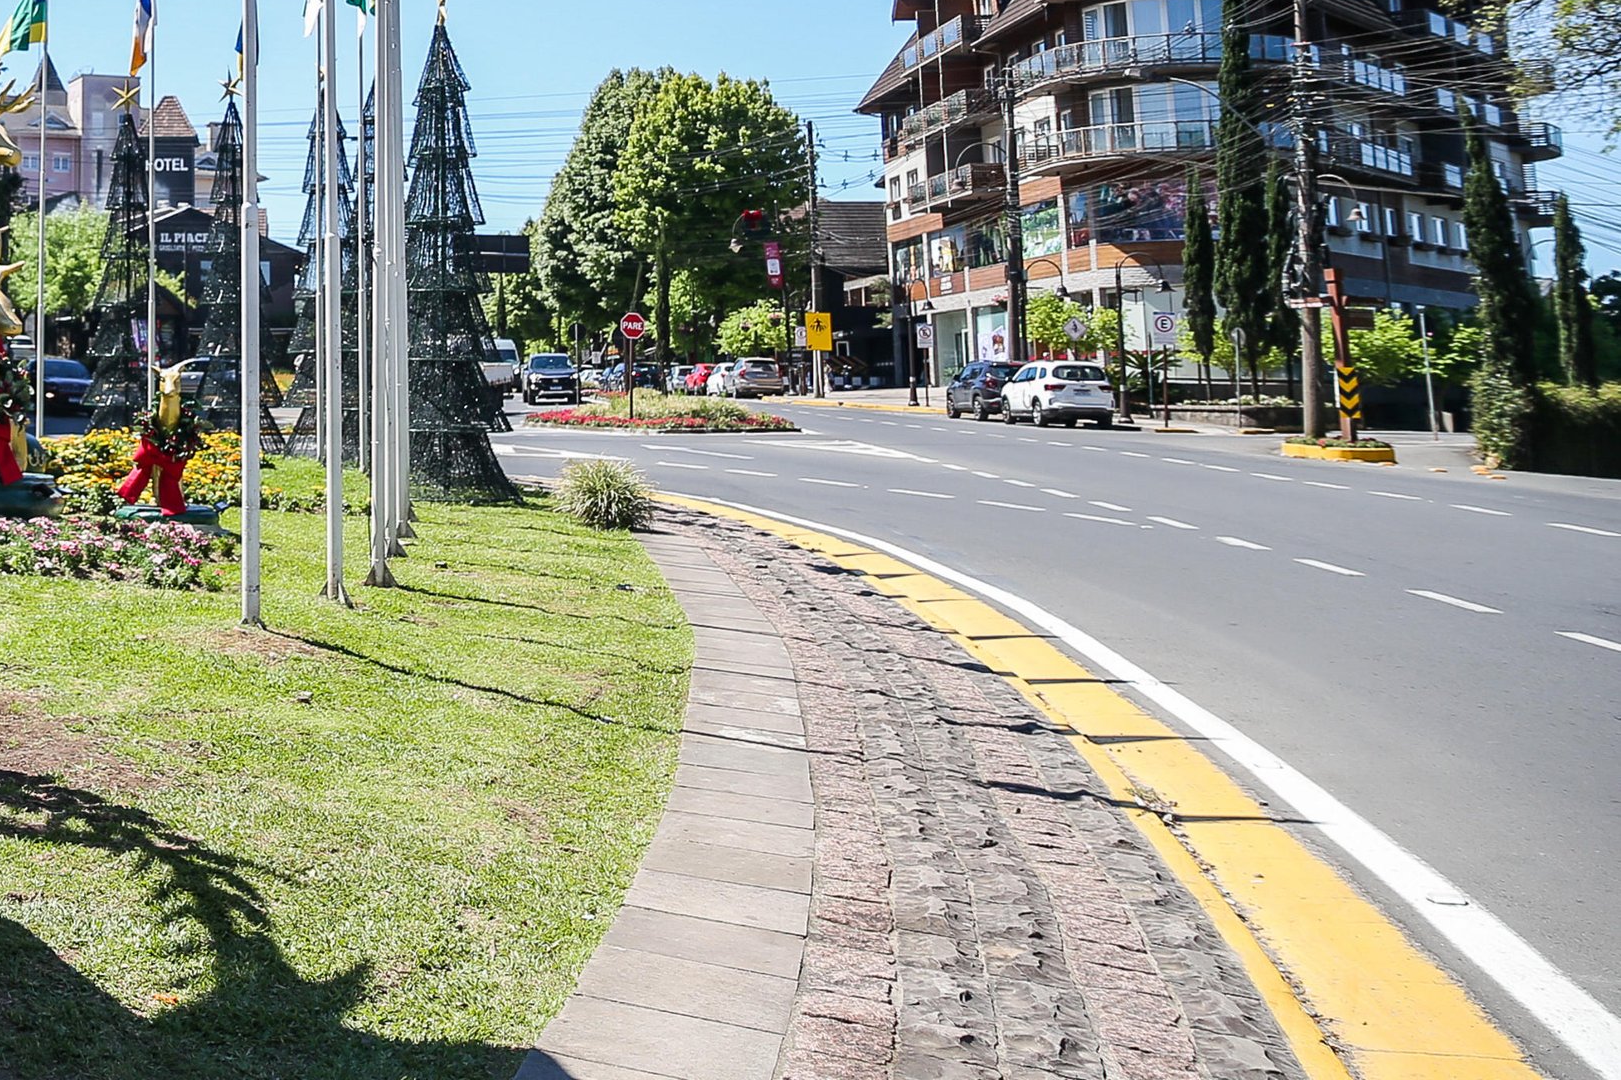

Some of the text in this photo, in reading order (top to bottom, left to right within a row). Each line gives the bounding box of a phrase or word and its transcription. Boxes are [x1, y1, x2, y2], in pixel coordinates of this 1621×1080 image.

[160, 233, 172, 243] IL
[623, 321, 643, 330] PARE
[1160, 319, 1168, 329] E
